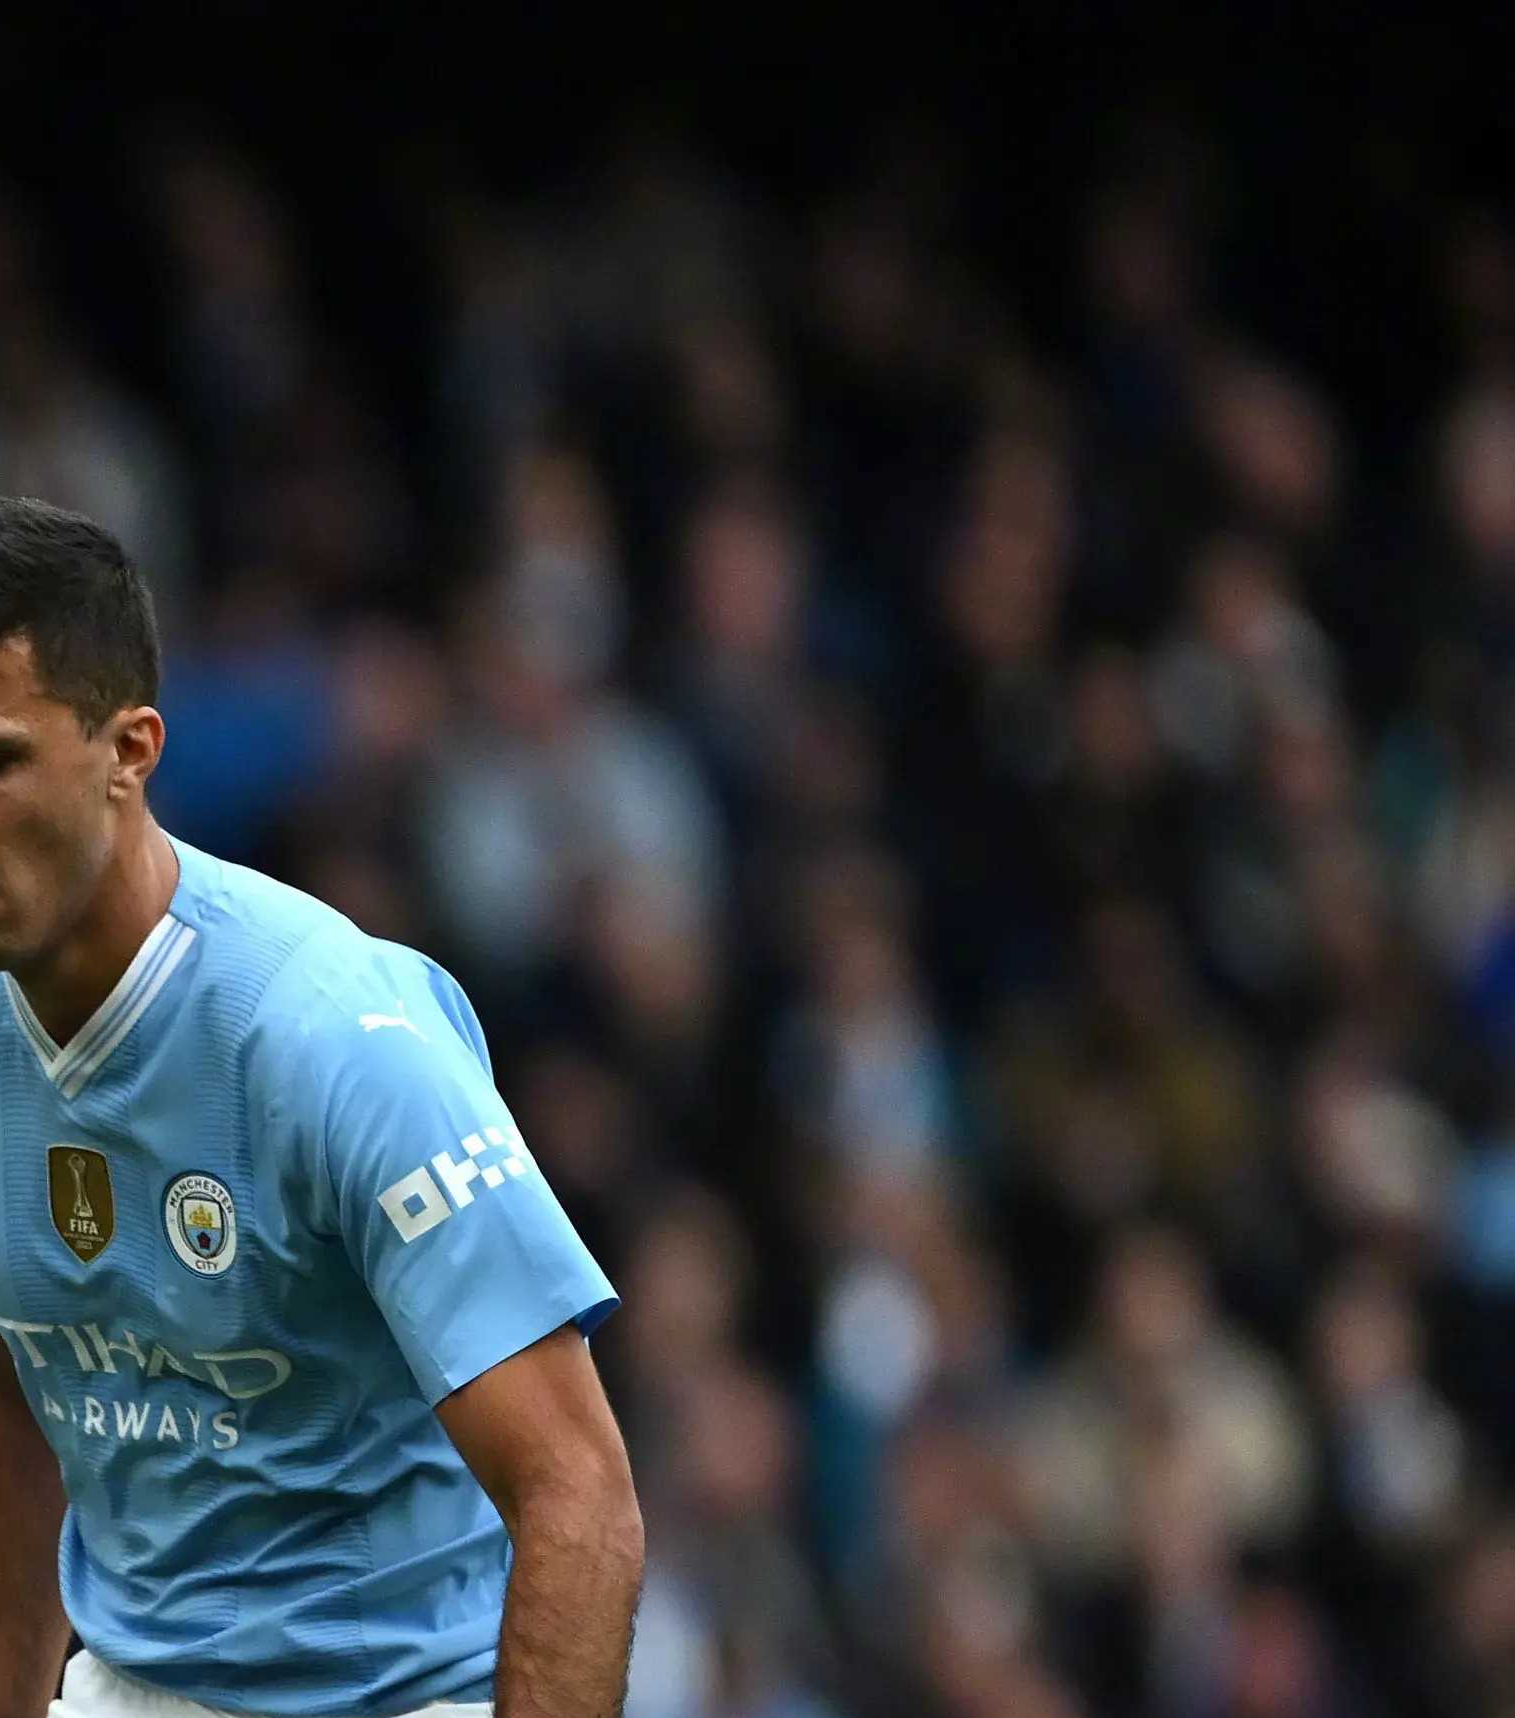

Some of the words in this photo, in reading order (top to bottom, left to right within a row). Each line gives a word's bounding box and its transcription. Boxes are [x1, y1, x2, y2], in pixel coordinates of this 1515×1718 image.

[170, 1178, 233, 1214] MANCHESTER
[69, 1218, 99, 1236] FIFA
[195, 1260, 219, 1271] CITY
